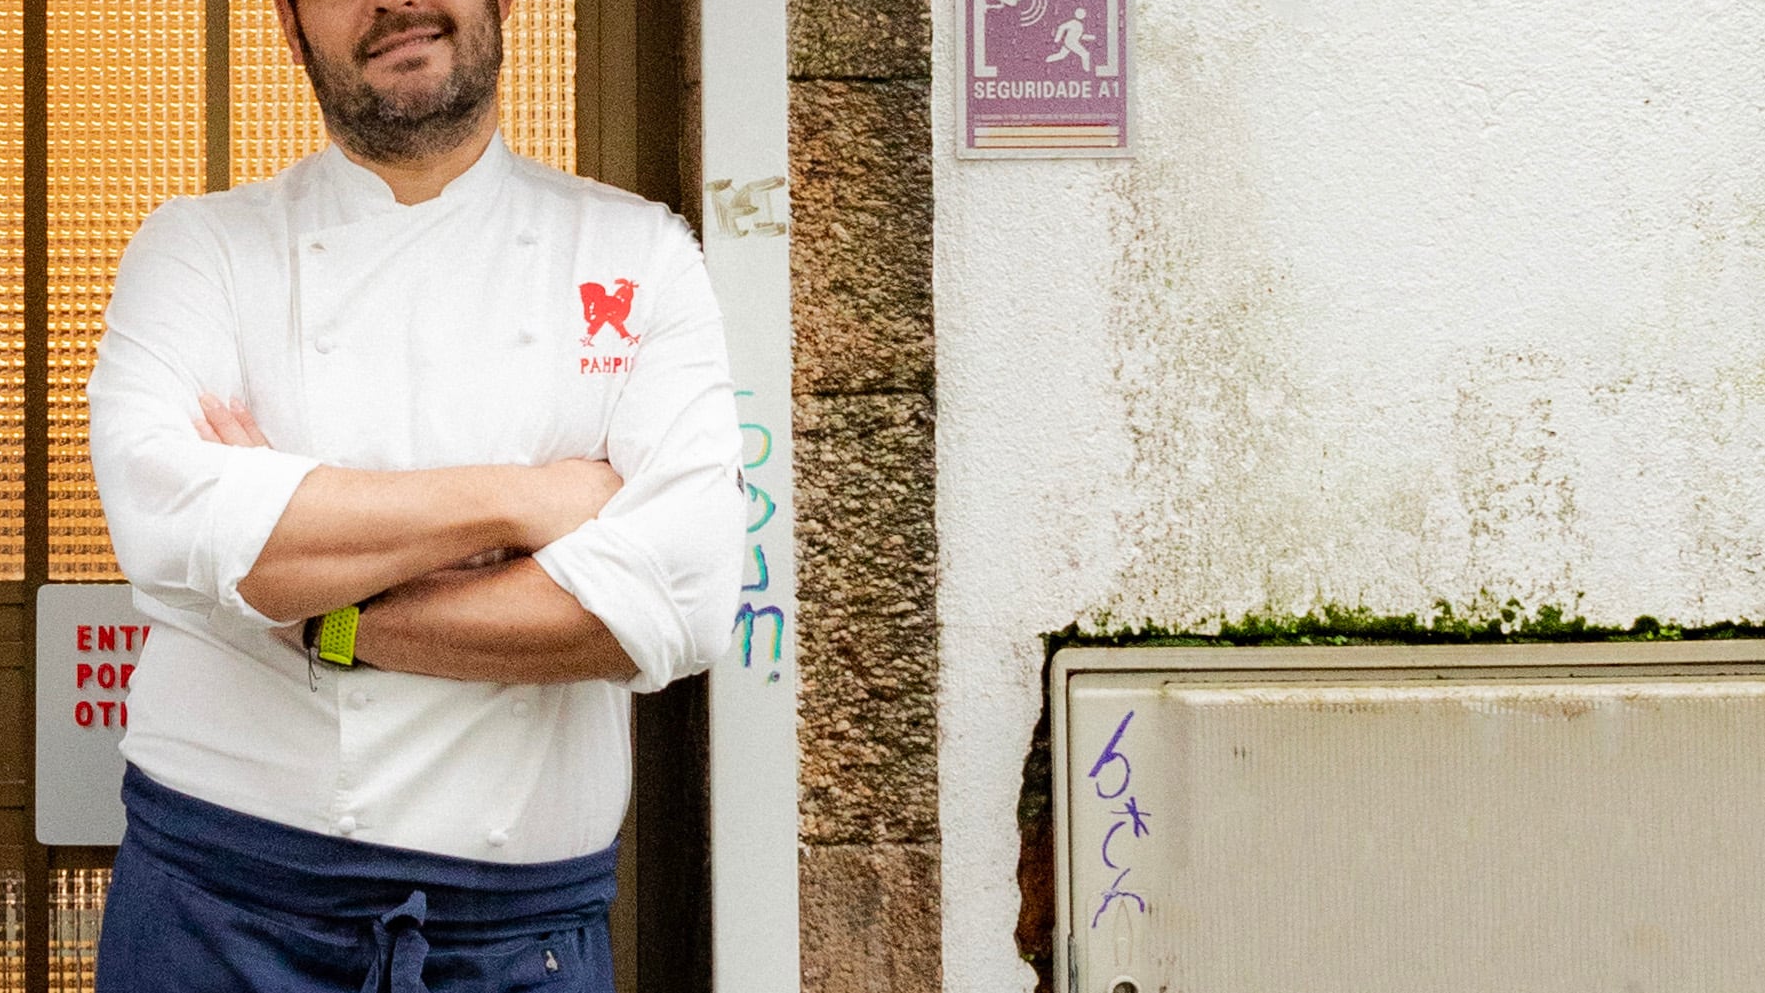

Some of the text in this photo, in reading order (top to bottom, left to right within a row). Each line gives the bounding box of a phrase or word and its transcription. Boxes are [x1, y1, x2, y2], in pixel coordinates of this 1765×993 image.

[973, 80, 1120, 100] SEGURIDADE A1
[76, 624, 151, 653] ENT
